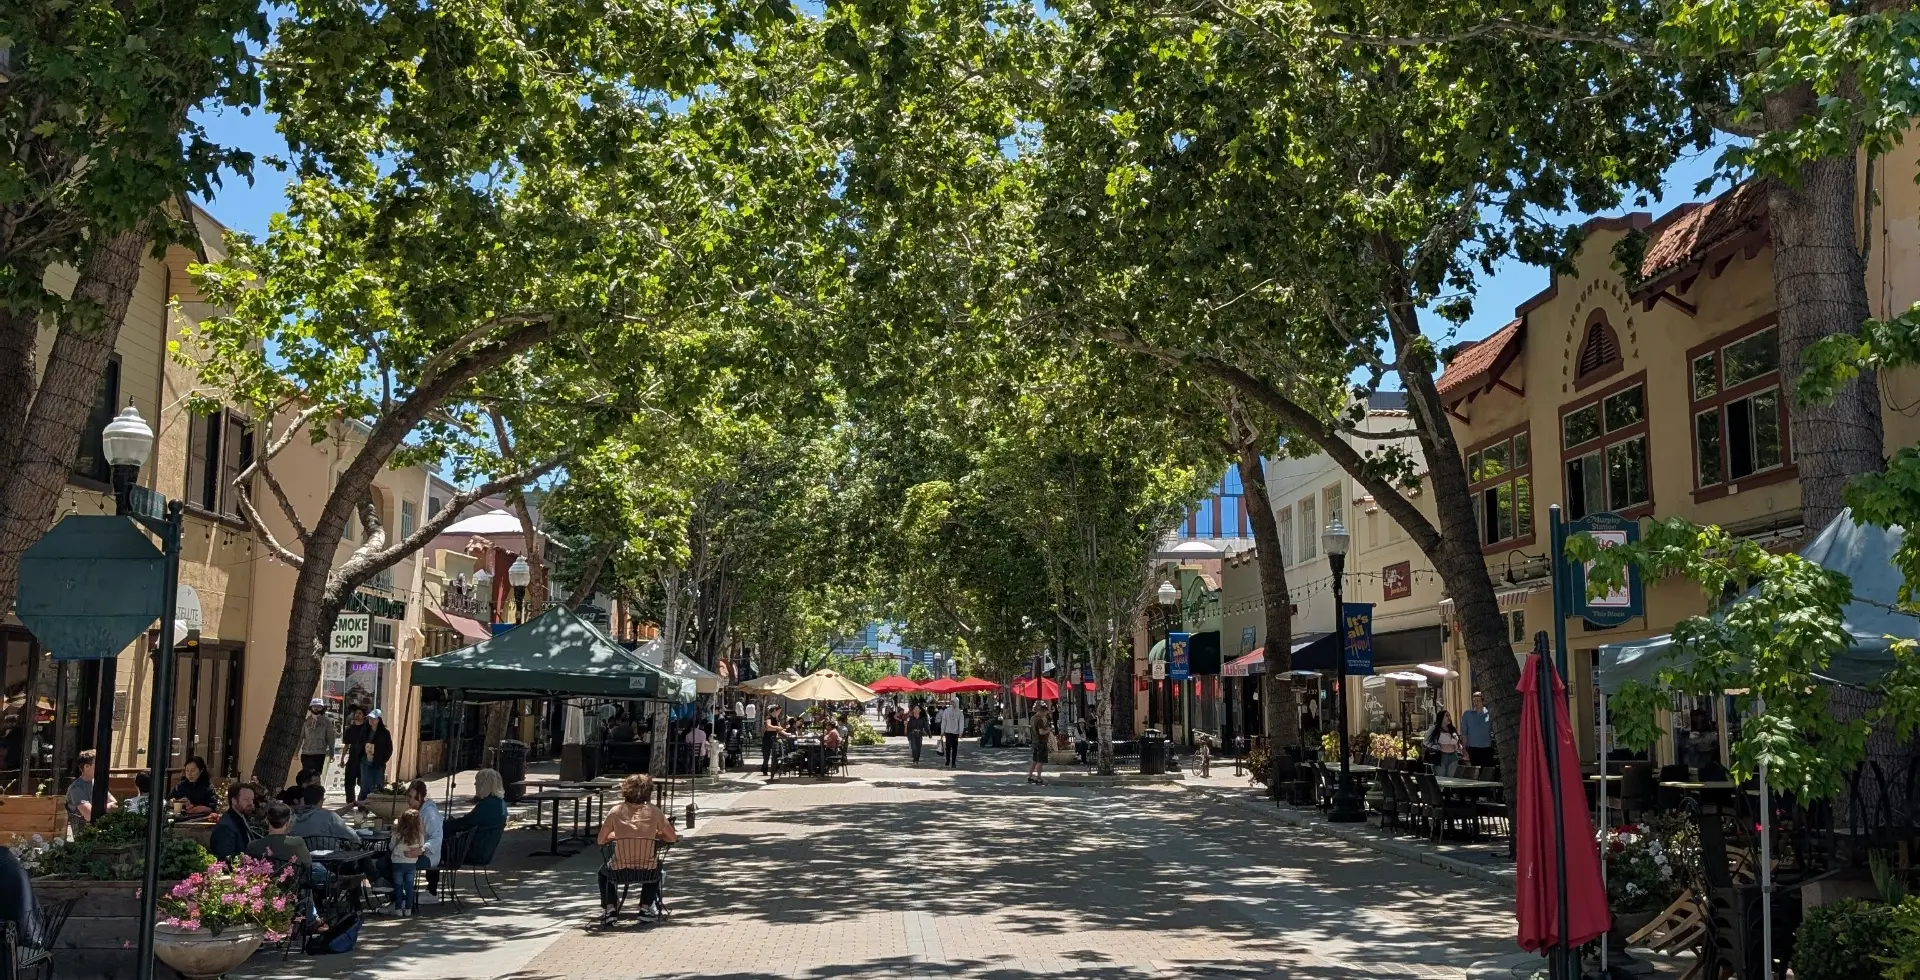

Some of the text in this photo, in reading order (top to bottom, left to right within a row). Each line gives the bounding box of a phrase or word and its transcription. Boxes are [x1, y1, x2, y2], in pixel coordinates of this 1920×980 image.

[1587, 516, 1620, 525] Murphy
[1347, 615, 1368, 628] It's
[1348, 625, 1365, 638] all
[335, 635, 363, 648] SHOP
